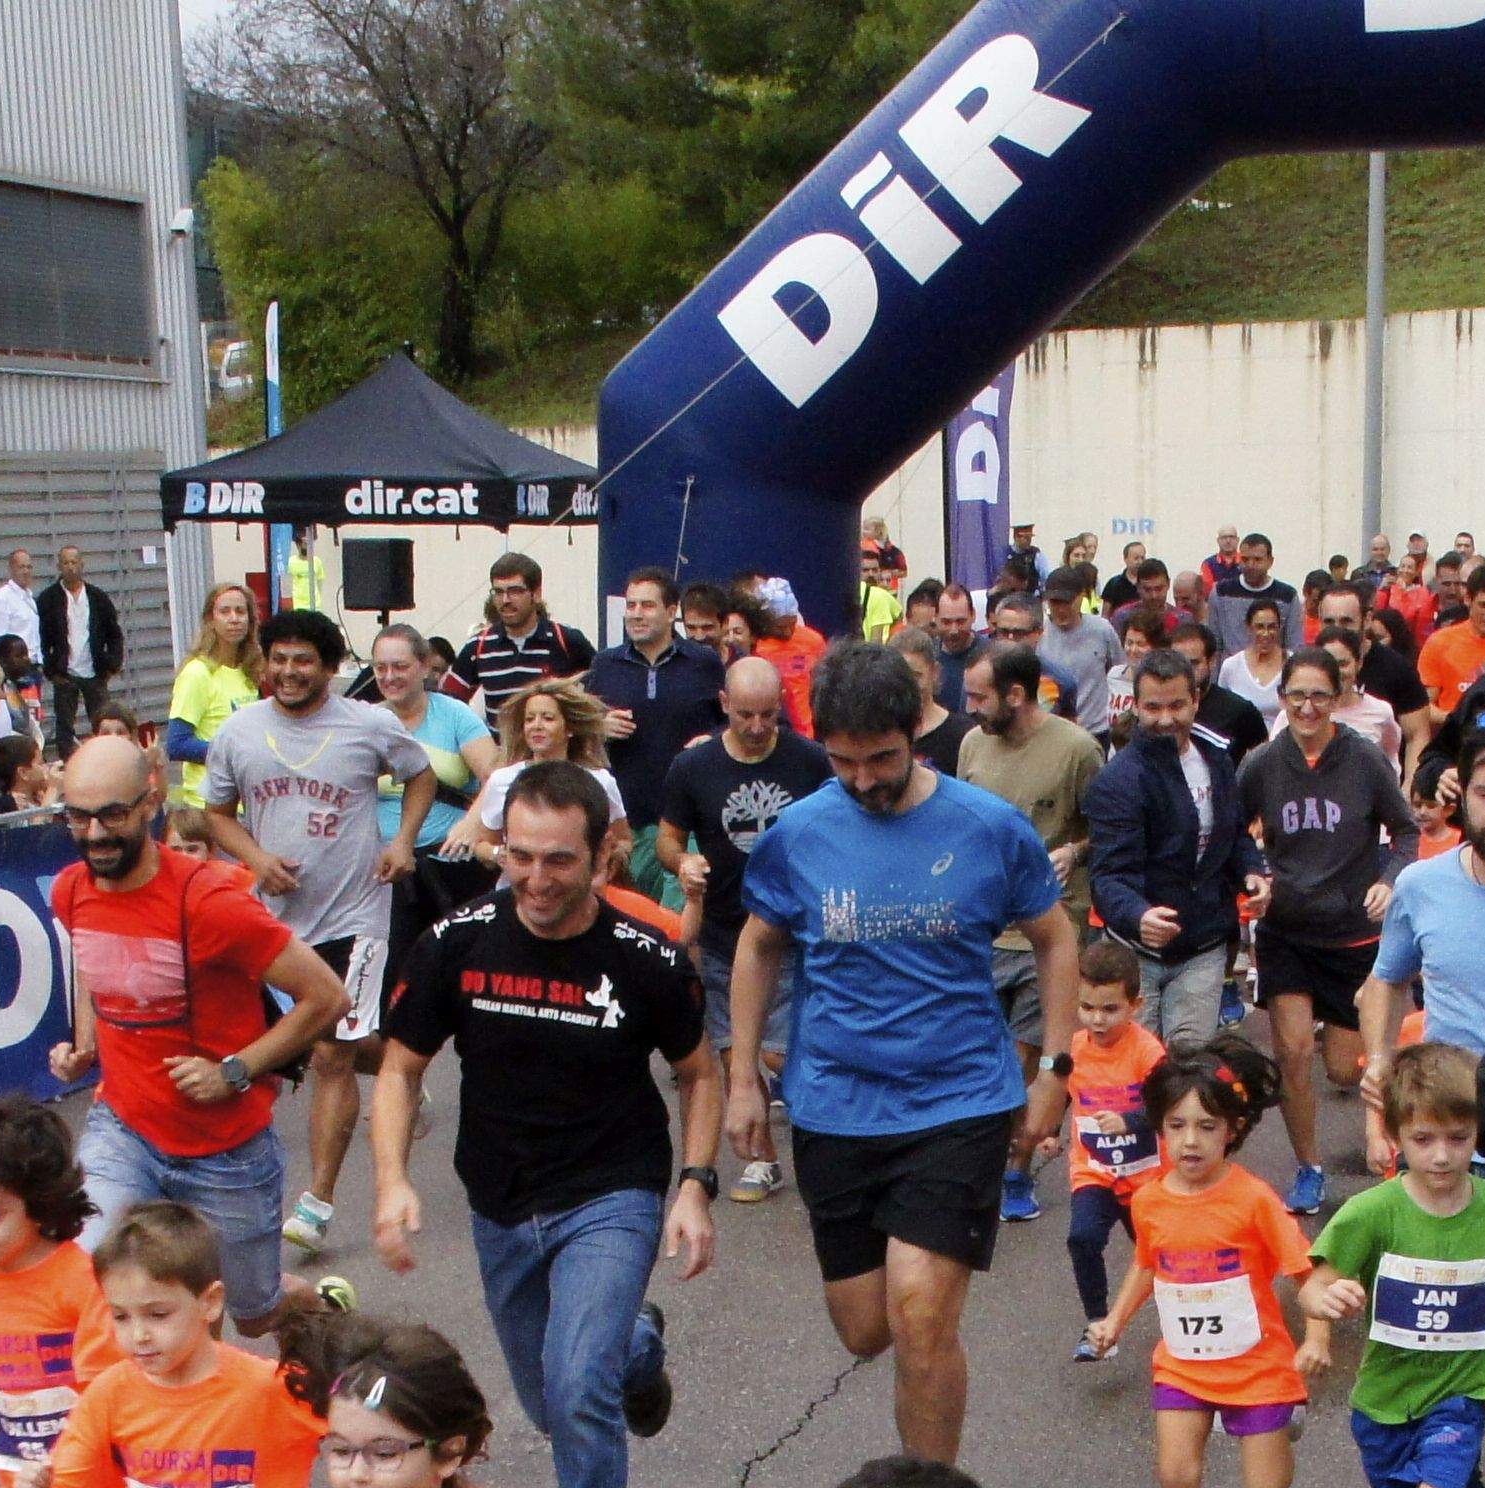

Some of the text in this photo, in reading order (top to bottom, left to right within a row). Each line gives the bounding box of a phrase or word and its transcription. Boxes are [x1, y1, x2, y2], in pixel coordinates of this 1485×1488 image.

[717, 33, 1093, 409] DiR
[207, 482, 265, 514] DiR
[345, 479, 480, 516] dir.cat
[252, 776, 350, 809] NEW YORK
[307, 811, 339, 837] 52
[1282, 797, 1343, 835] GAP
[502, 1003, 536, 1018] MARTIAL
[538, 1007, 559, 1021] ARTS
[560, 1010, 599, 1027] ACADEMY
[1096, 1133, 1137, 1149] ALAN
[1111, 1149, 1124, 1165] 9
[1411, 1289, 1458, 1307] JAN
[1178, 1315, 1224, 1336] 173
[1415, 1310, 1450, 1331] 59
[140, 1450, 208, 1472] CURSA
